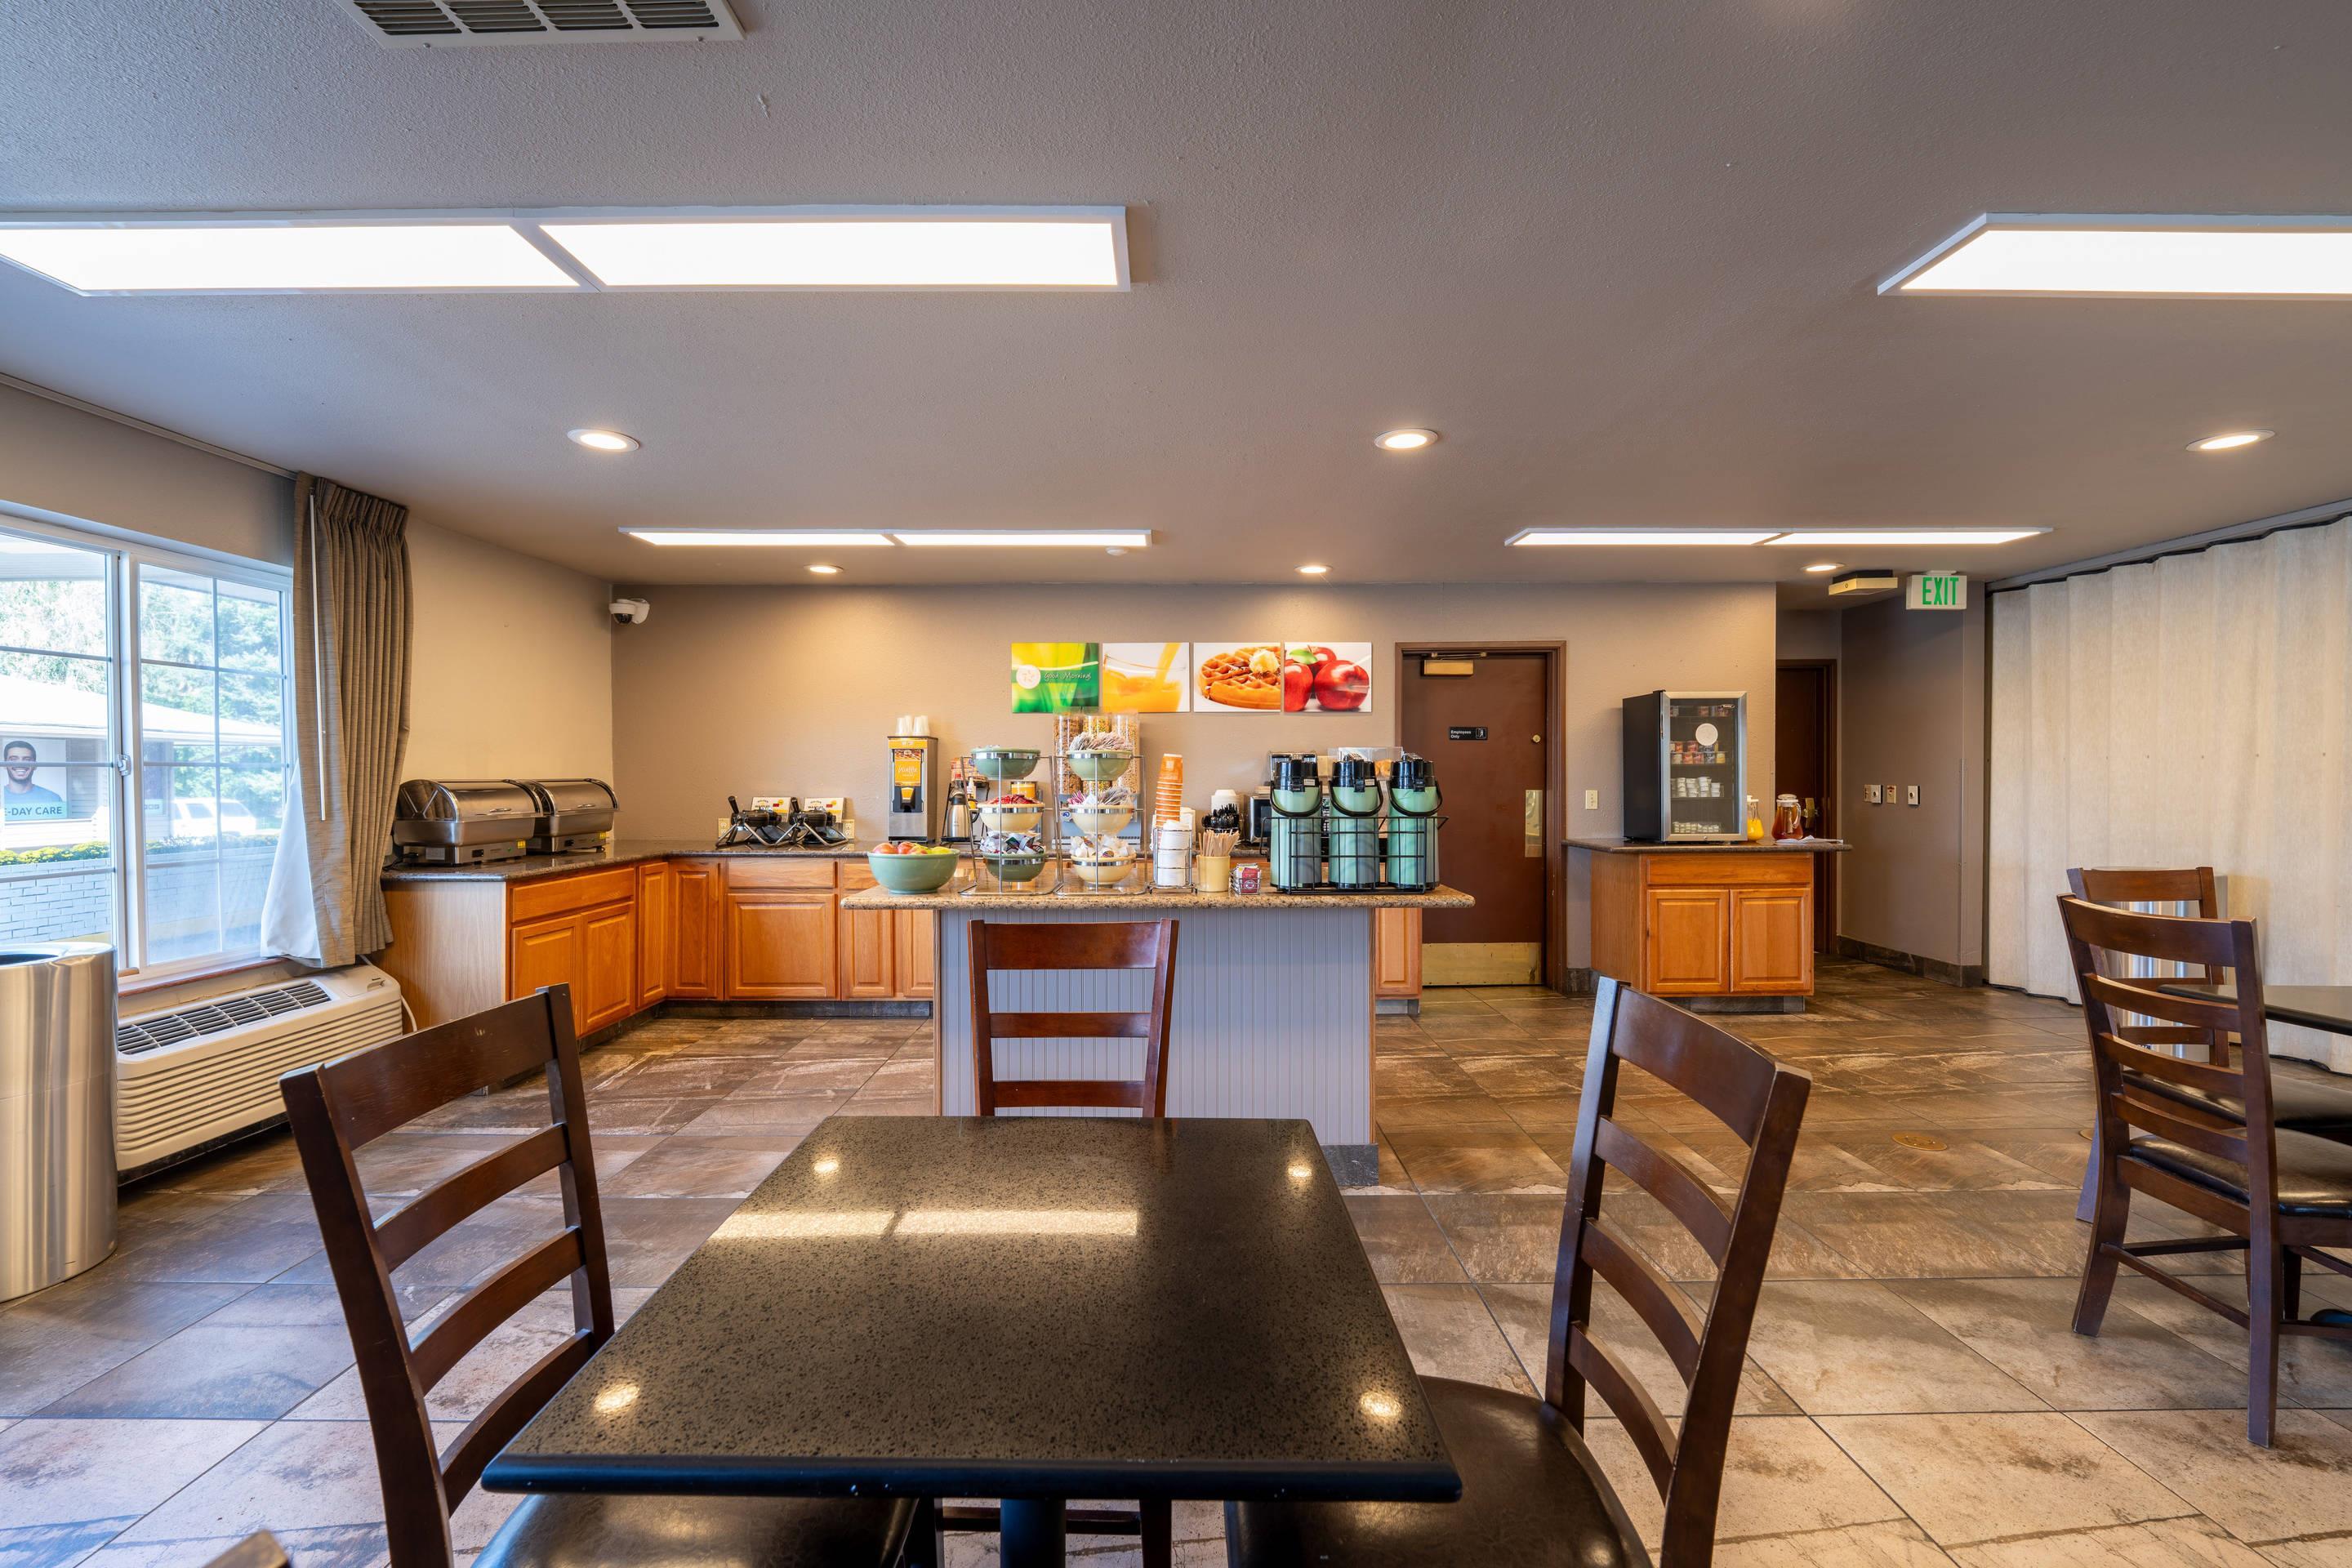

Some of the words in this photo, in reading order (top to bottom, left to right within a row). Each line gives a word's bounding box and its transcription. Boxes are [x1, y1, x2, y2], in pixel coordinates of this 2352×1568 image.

[1922, 577, 1959, 605] EXIT
[1045, 672, 1059, 682] Good
[1061, 672, 1092, 681] Morning!
[35, 806, 63, 815] CARE
